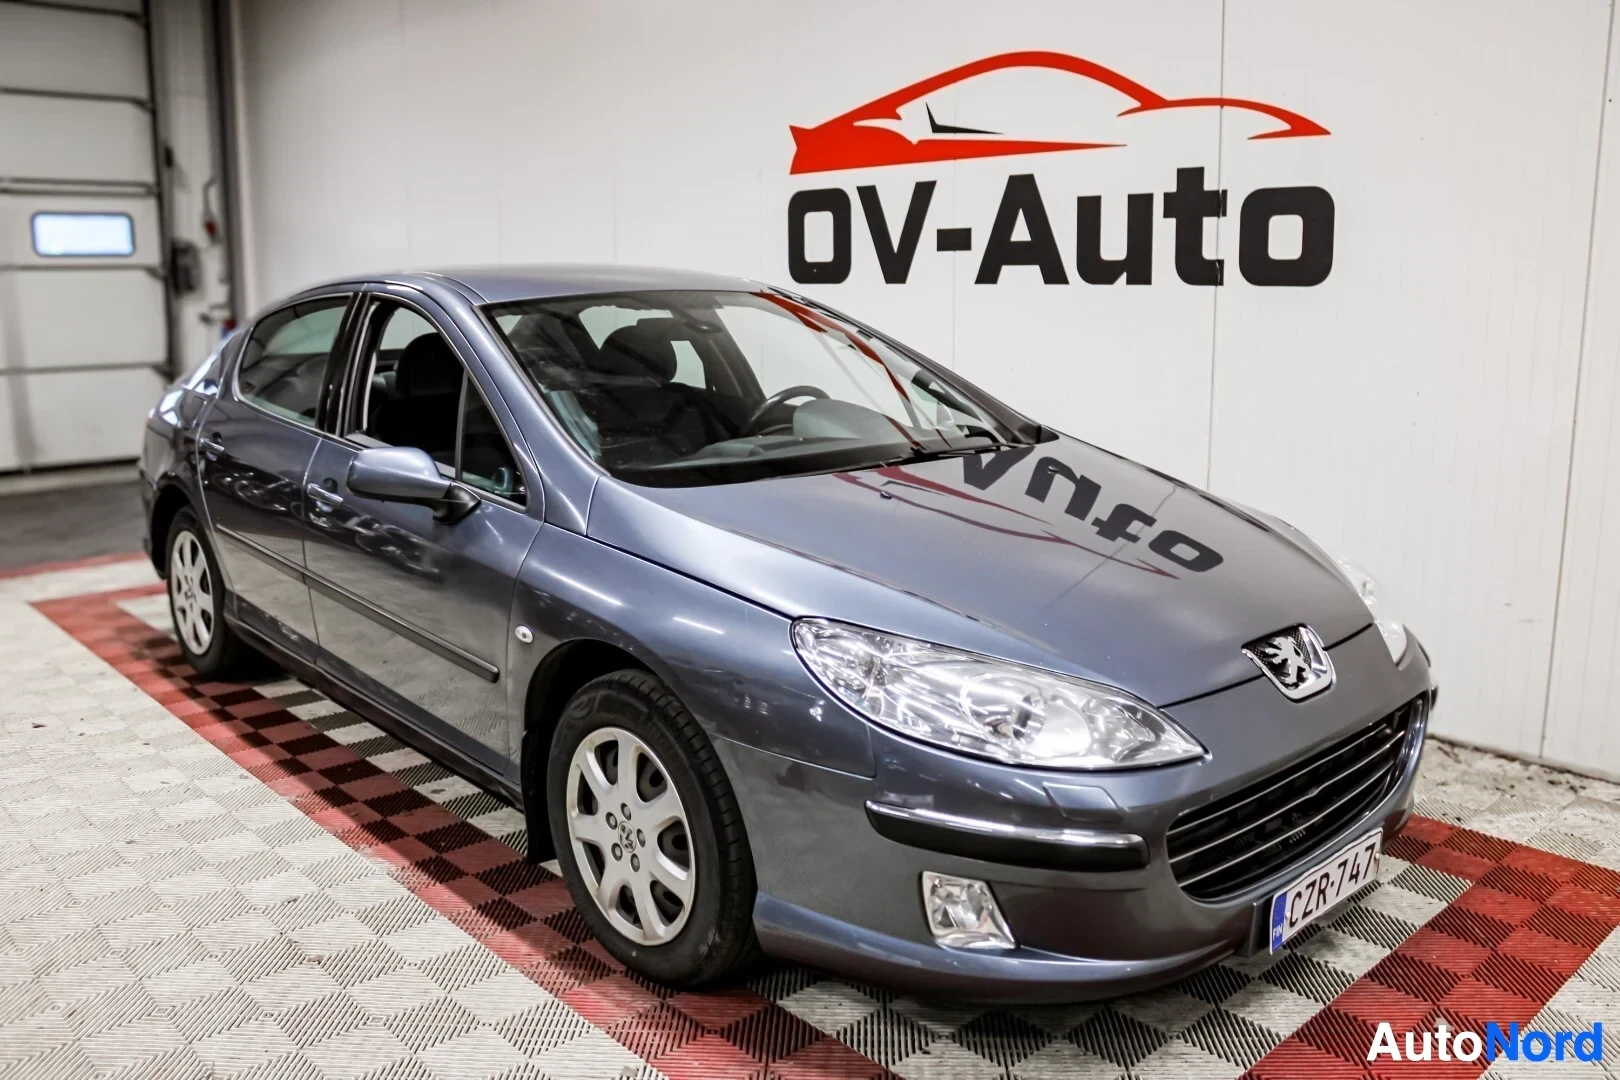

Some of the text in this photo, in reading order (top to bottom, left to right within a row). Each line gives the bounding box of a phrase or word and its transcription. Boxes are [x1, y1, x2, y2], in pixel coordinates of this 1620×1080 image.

[788, 166, 1336, 287] OV-Auto
[1289, 842, 1377, 928] CZR-747
[1272, 922, 1284, 941] FIN
